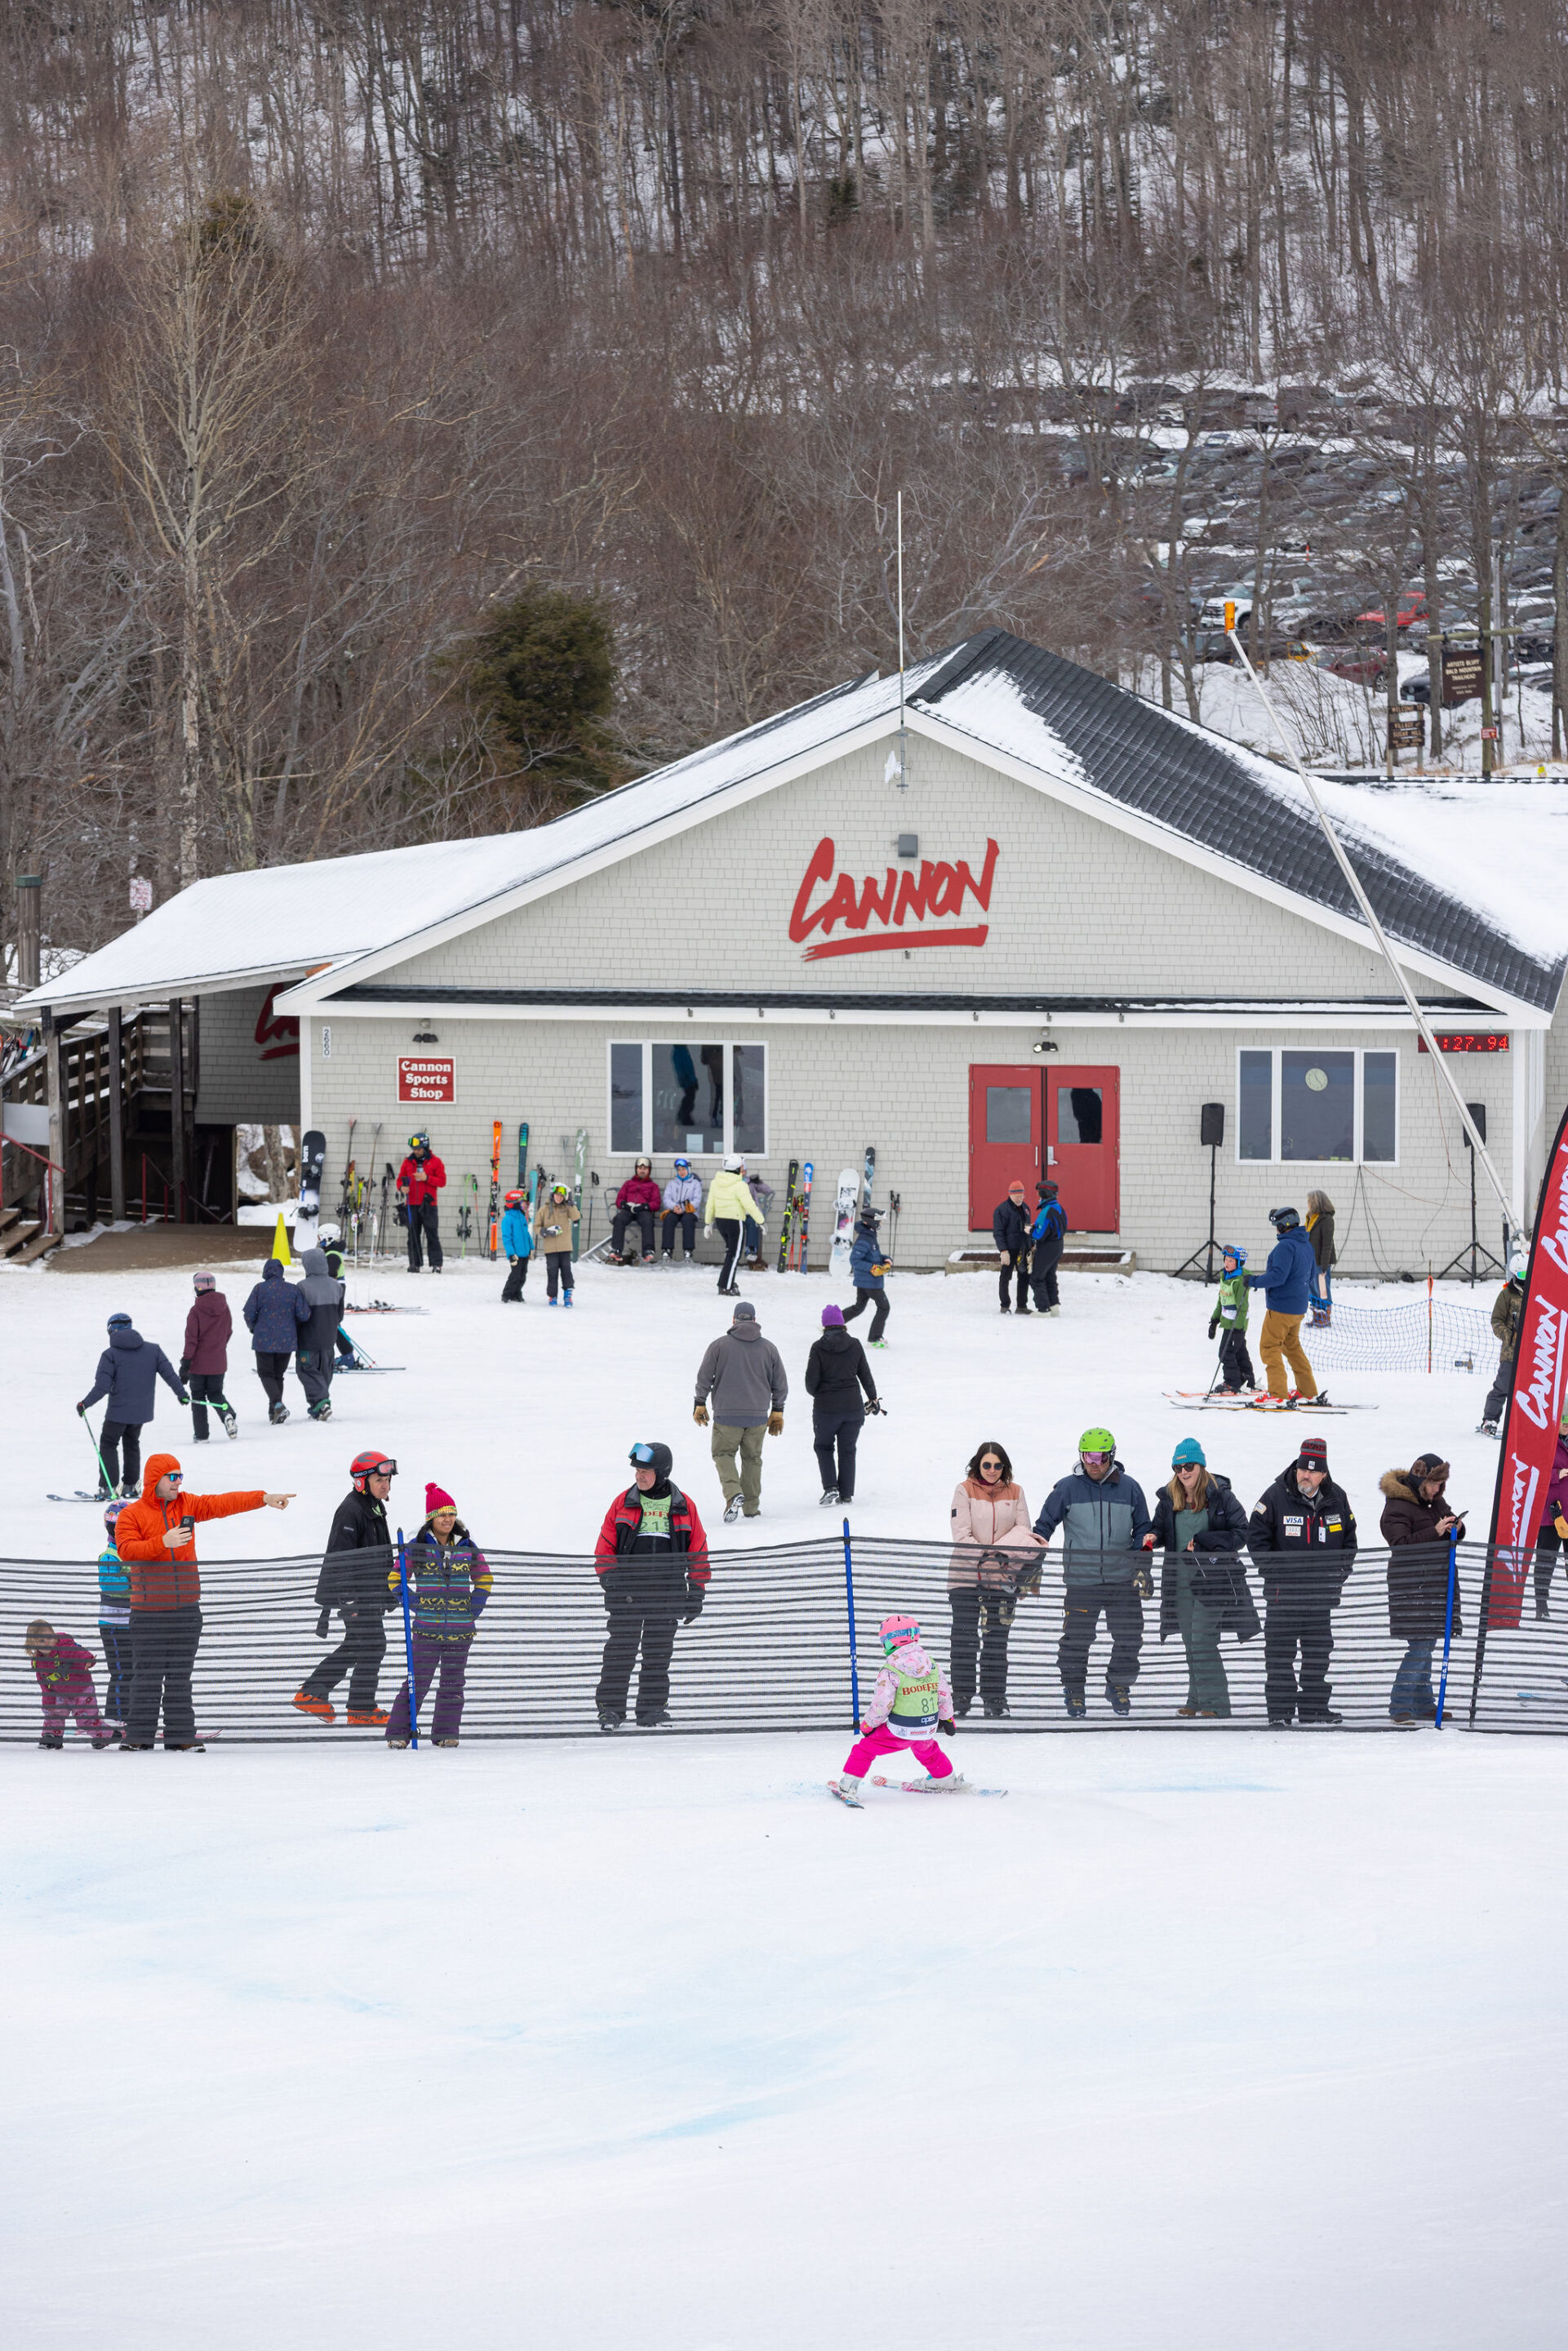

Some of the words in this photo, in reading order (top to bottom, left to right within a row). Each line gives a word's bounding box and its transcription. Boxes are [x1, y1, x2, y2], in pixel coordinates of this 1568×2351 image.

[788, 837, 1000, 943] CANNON
[1434, 1035, 1508, 1051] :27.94
[401, 1060, 451, 1073] Cannon
[405, 1073, 448, 1086] Sports
[410, 1087, 443, 1100] Shop
[1515, 1295, 1559, 1429] CANNON
[921, 1697, 935, 1713] 81
